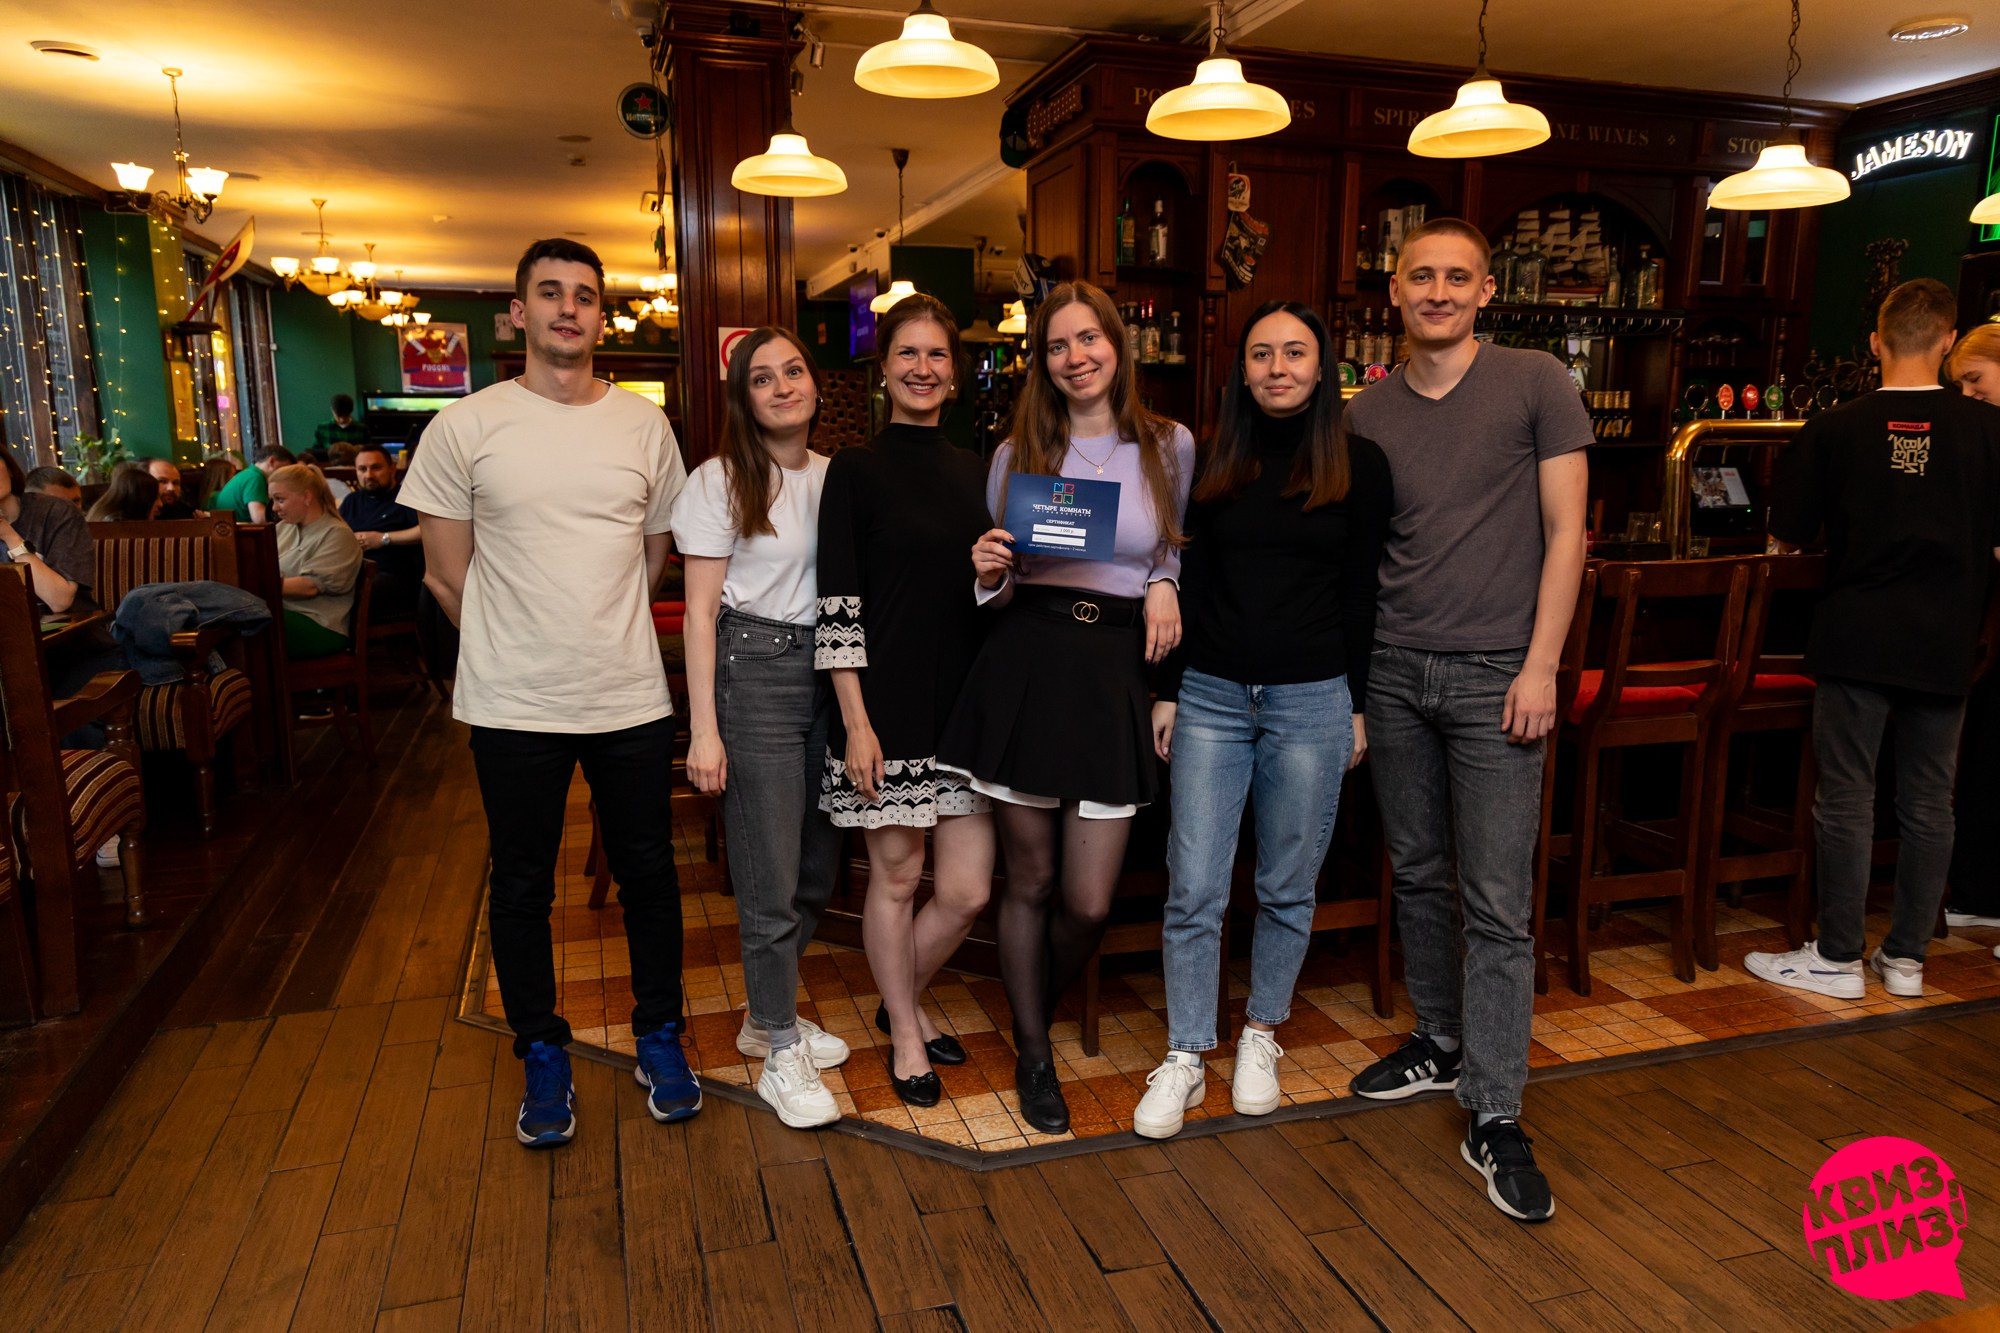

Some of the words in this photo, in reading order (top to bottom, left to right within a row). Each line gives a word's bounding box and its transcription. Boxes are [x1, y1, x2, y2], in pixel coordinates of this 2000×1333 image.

[1374, 106, 1429, 127] SPIR
[1588, 125, 1649, 146] WINES
[1728, 136, 1769, 154] STO
[1851, 128, 1974, 181] JAMESON
[1059, 506, 1091, 514] КОМНАТЫ
